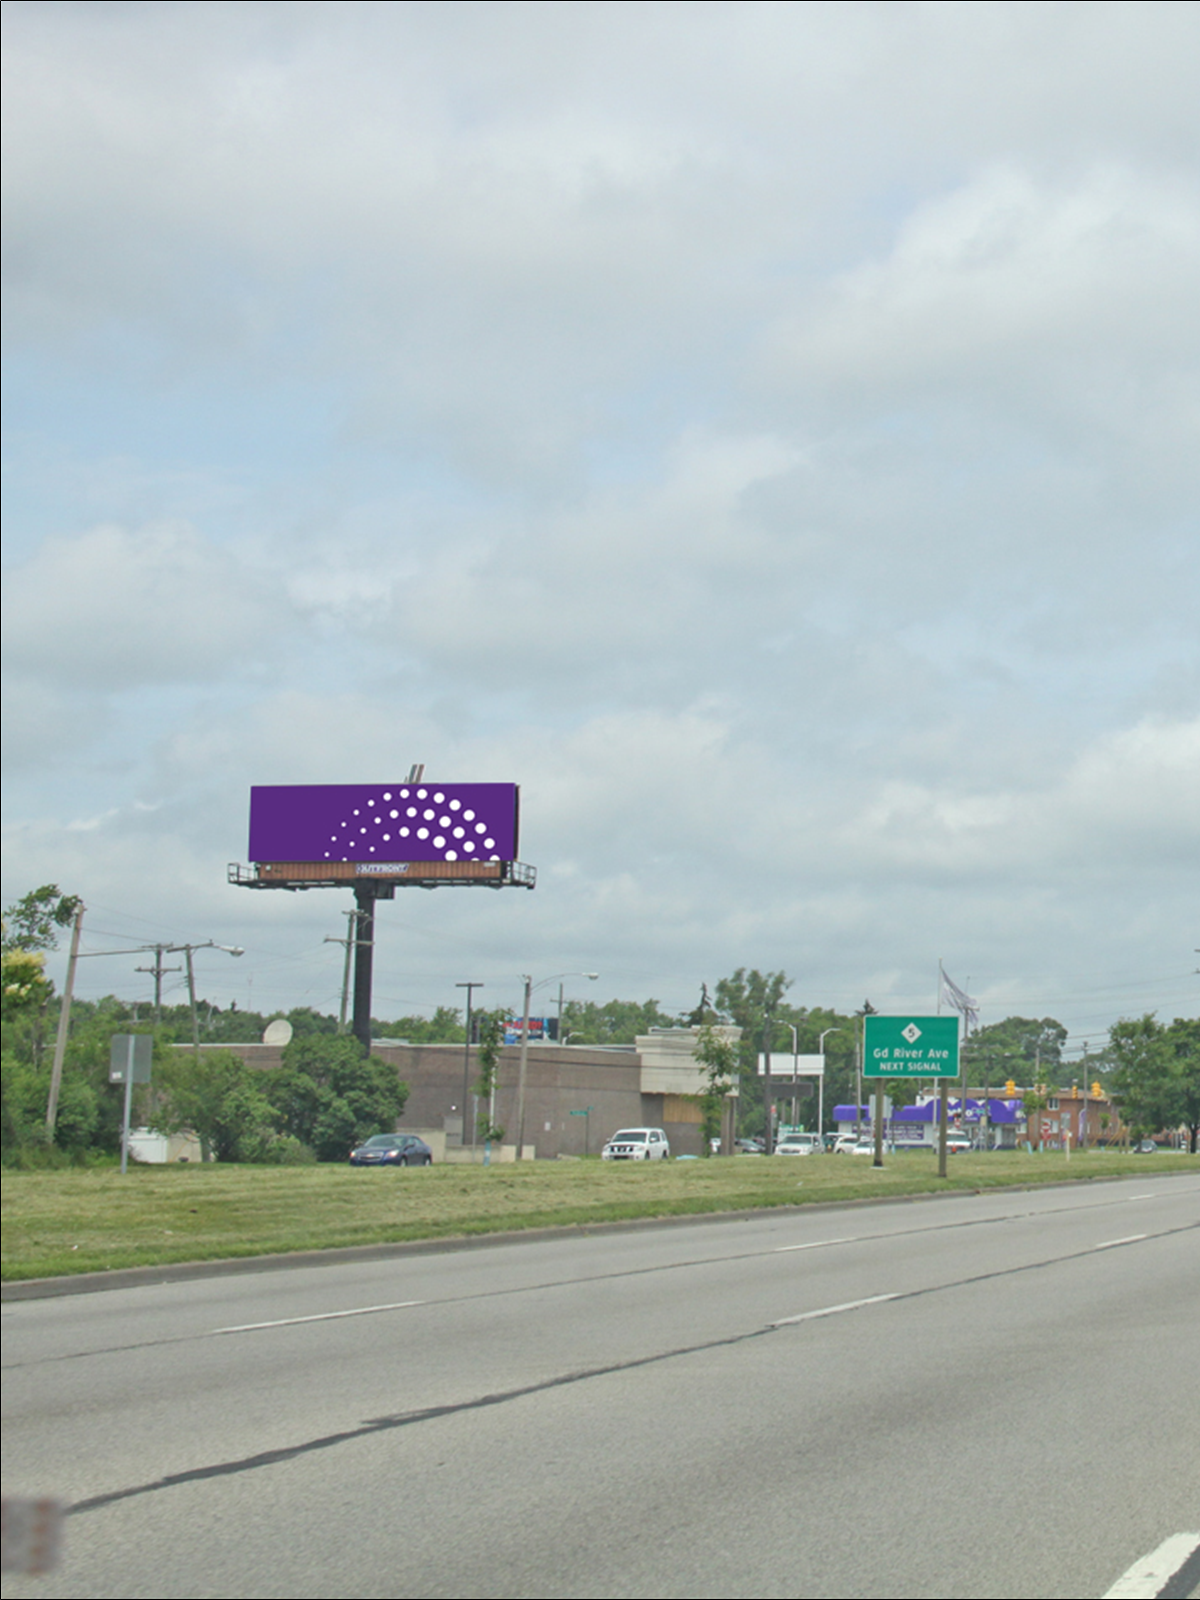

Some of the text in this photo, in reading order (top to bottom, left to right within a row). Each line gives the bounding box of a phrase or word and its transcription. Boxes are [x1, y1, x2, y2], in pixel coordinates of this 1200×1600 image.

[907, 1027, 916, 1038] 5
[873, 1047, 949, 1059] Gd River Ave
[879, 1062, 942, 1071] NEXT SIGNAL
